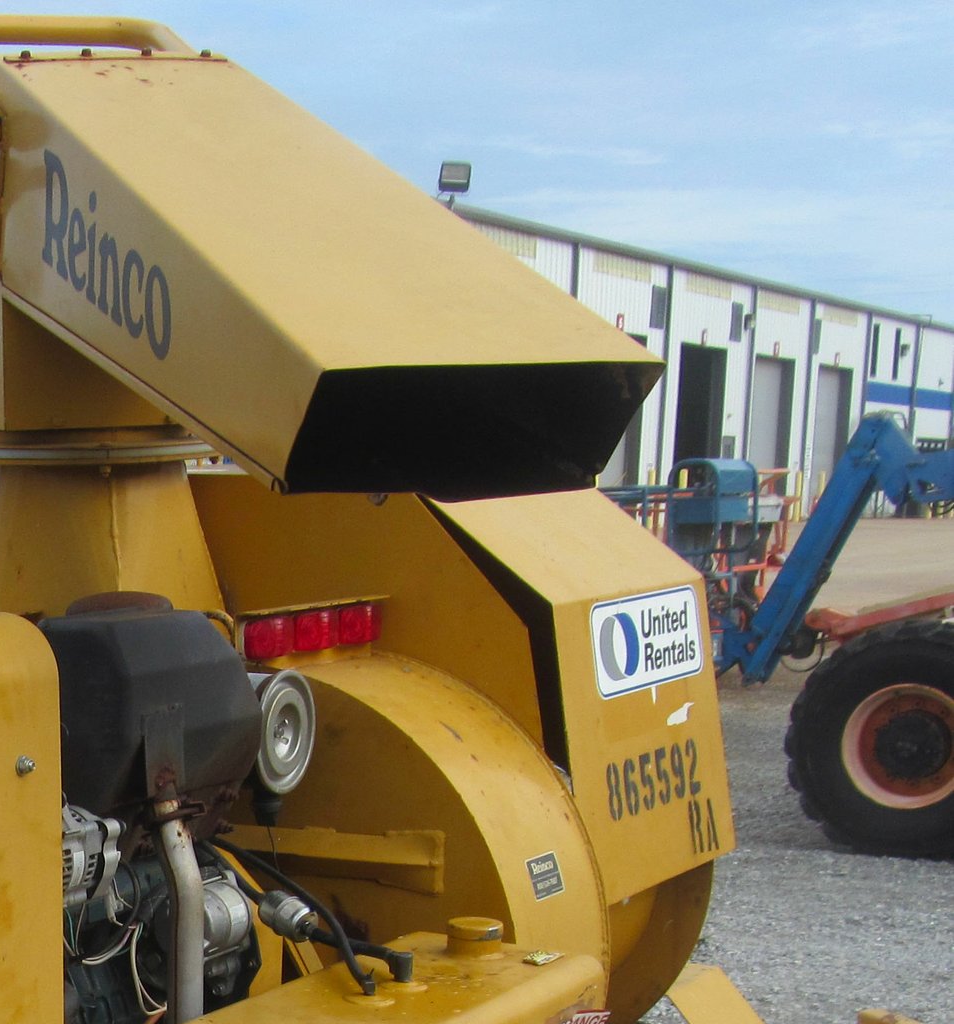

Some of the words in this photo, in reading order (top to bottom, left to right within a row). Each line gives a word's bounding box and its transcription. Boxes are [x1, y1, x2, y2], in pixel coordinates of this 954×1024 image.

[42, 148, 171, 361] Reinco
[640, 601, 688, 638] United
[644, 633, 696, 672] Rentals
[606, 738, 701, 821] 865592
[688, 798, 719, 854] RA
